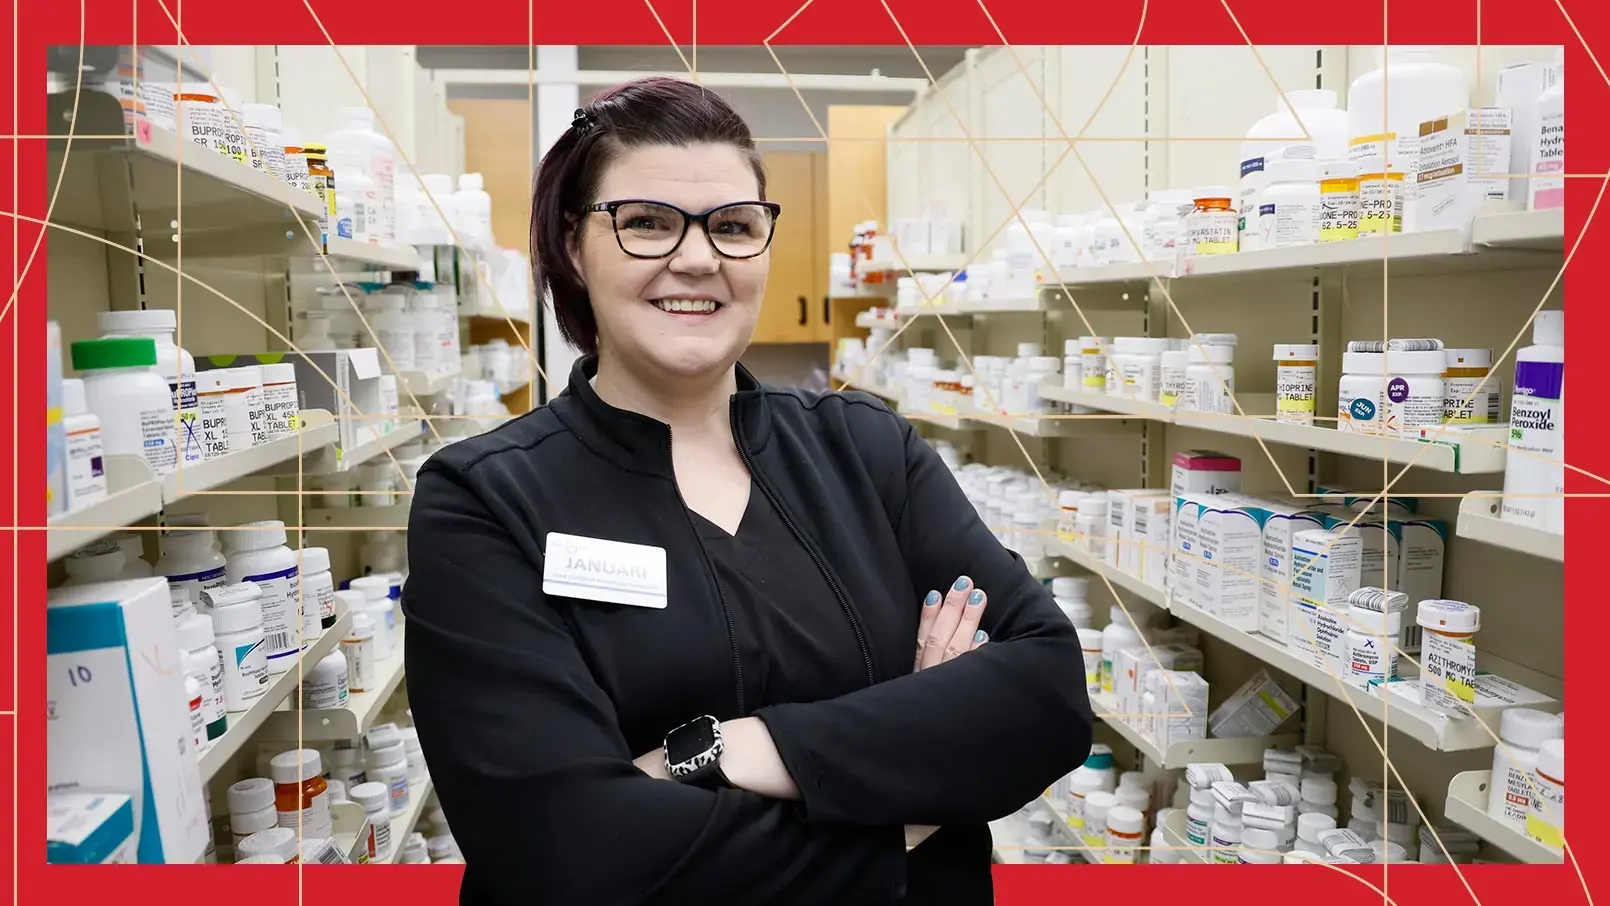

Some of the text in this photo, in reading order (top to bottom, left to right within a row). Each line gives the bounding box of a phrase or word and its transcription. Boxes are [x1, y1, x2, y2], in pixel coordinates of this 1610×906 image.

[1390, 384, 1405, 392] APR
[1284, 393, 1313, 401] TABLET
[1356, 401, 1372, 414] JUN
[1512, 406, 1552, 420] Benzoyl
[1511, 417, 1555, 431] Peroxide
[565, 556, 649, 579] JANUARI
[68, 665, 92, 687] 10
[1427, 663, 1442, 677] 500
[1445, 670, 1456, 682] MG
